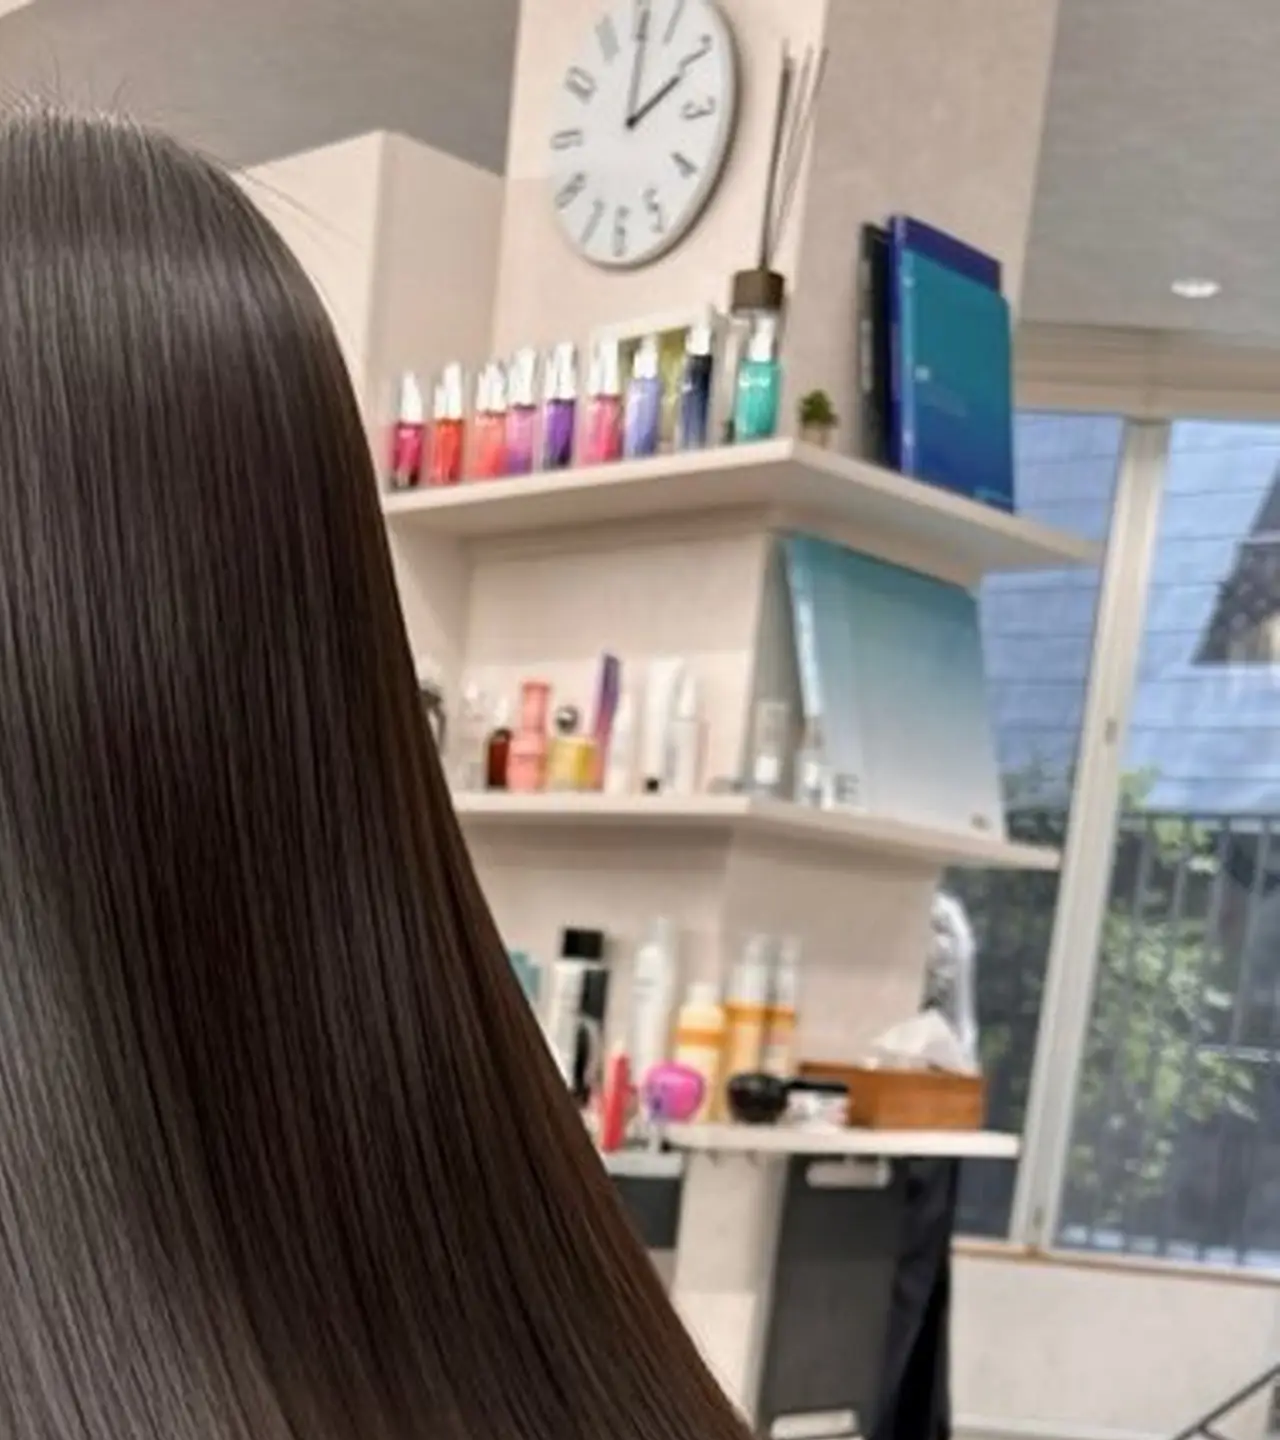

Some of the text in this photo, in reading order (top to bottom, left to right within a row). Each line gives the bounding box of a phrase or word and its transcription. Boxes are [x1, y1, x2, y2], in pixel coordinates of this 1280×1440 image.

[679, 33, 712, 76] 2
[681, 96, 716, 120] 3
[551, 130, 583, 150] 9
[671, 151, 698, 179] 4
[555, 172, 586, 209] 8
[642, 185, 663, 234] 5
[580, 200, 606, 245] 7
[613, 205, 630, 258] 6
